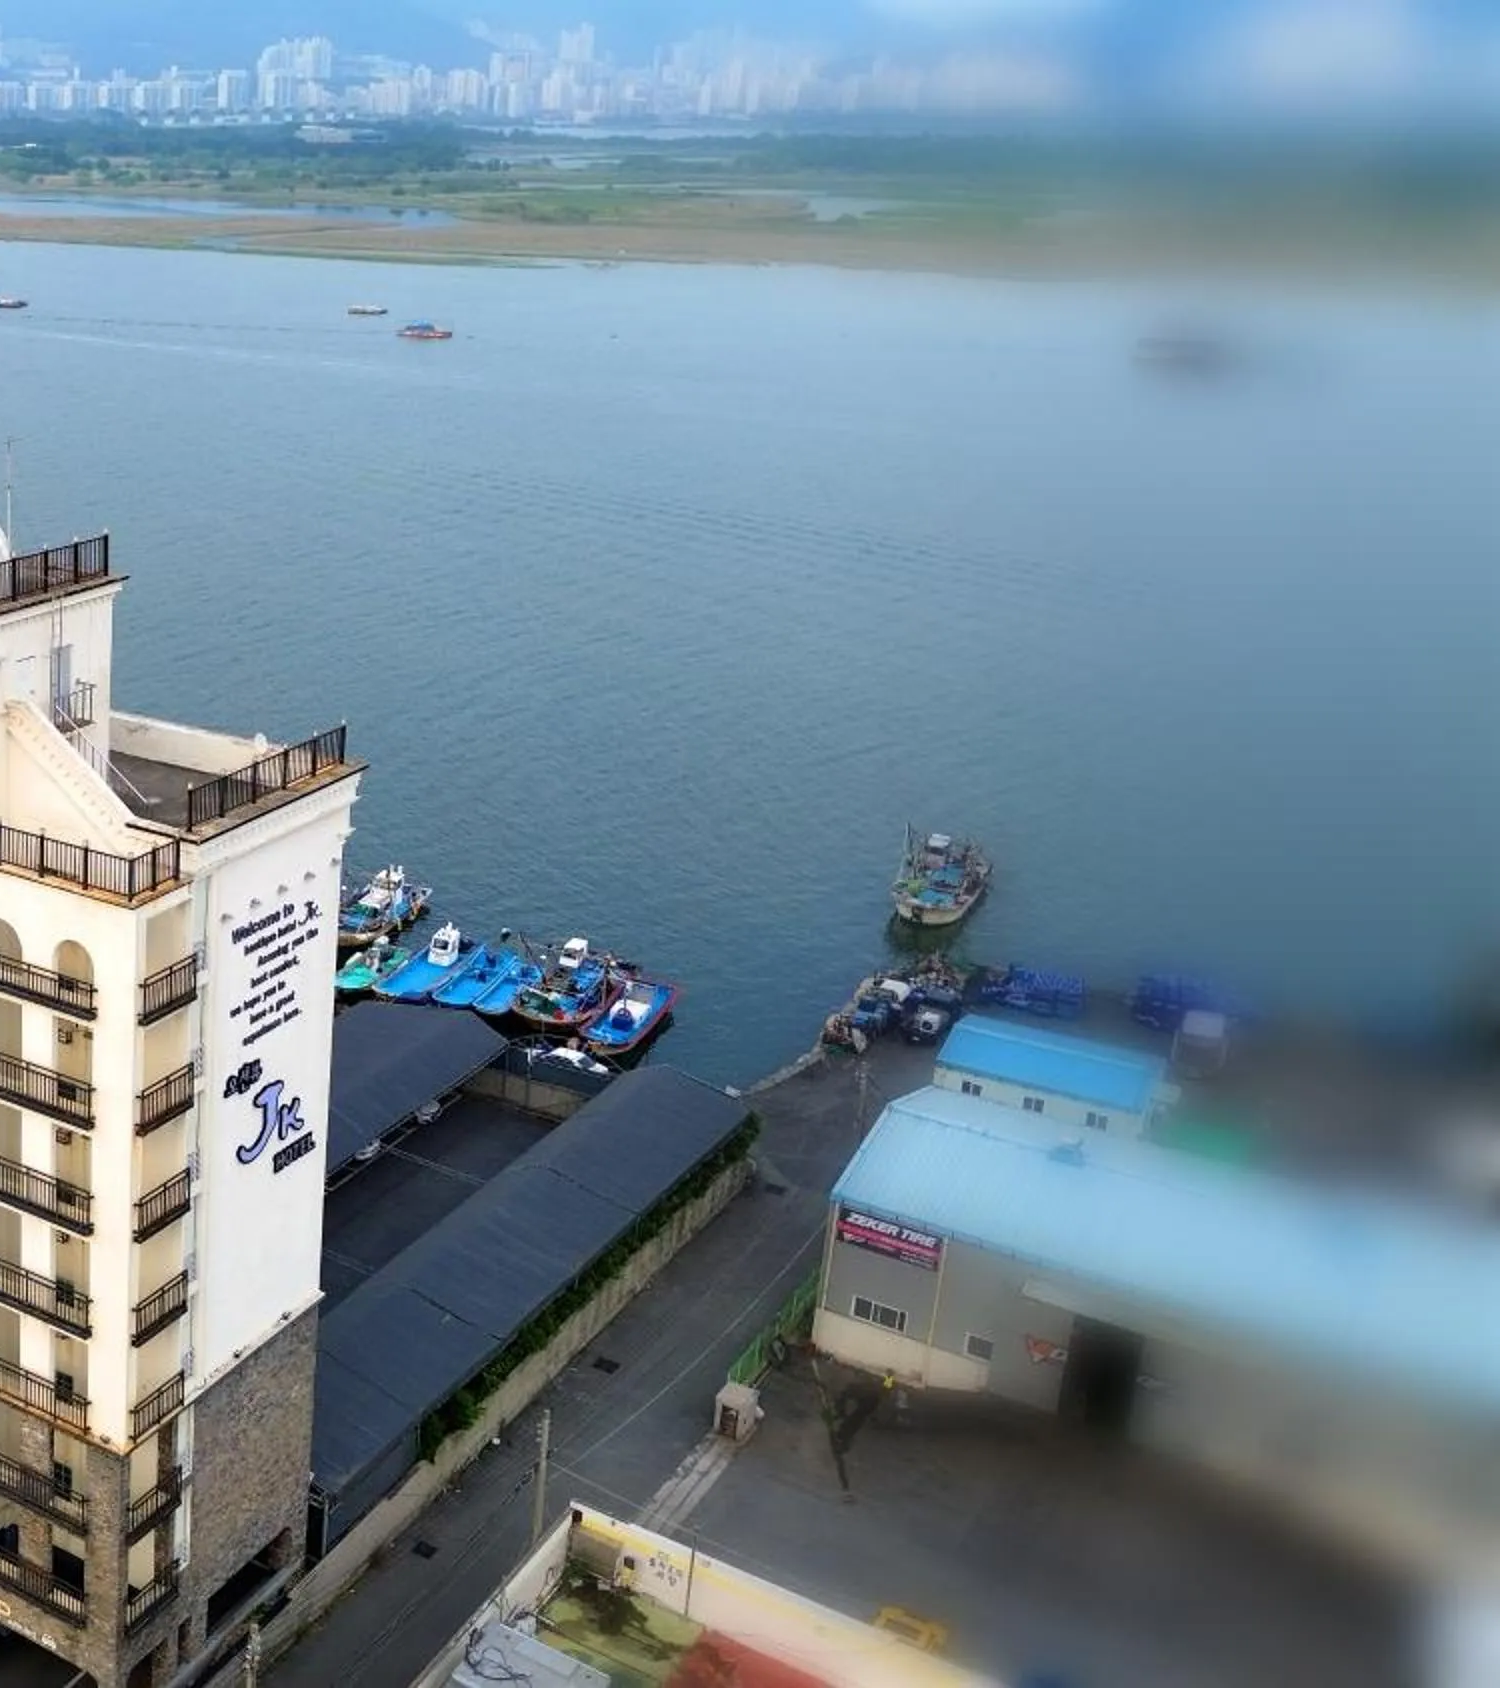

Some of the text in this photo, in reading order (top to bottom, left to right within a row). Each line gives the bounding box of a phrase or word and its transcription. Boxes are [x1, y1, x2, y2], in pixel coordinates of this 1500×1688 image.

[231, 903, 295, 945] Welcome to
[262, 985, 277, 1002] you
[272, 1131, 317, 1175] HOTEL
